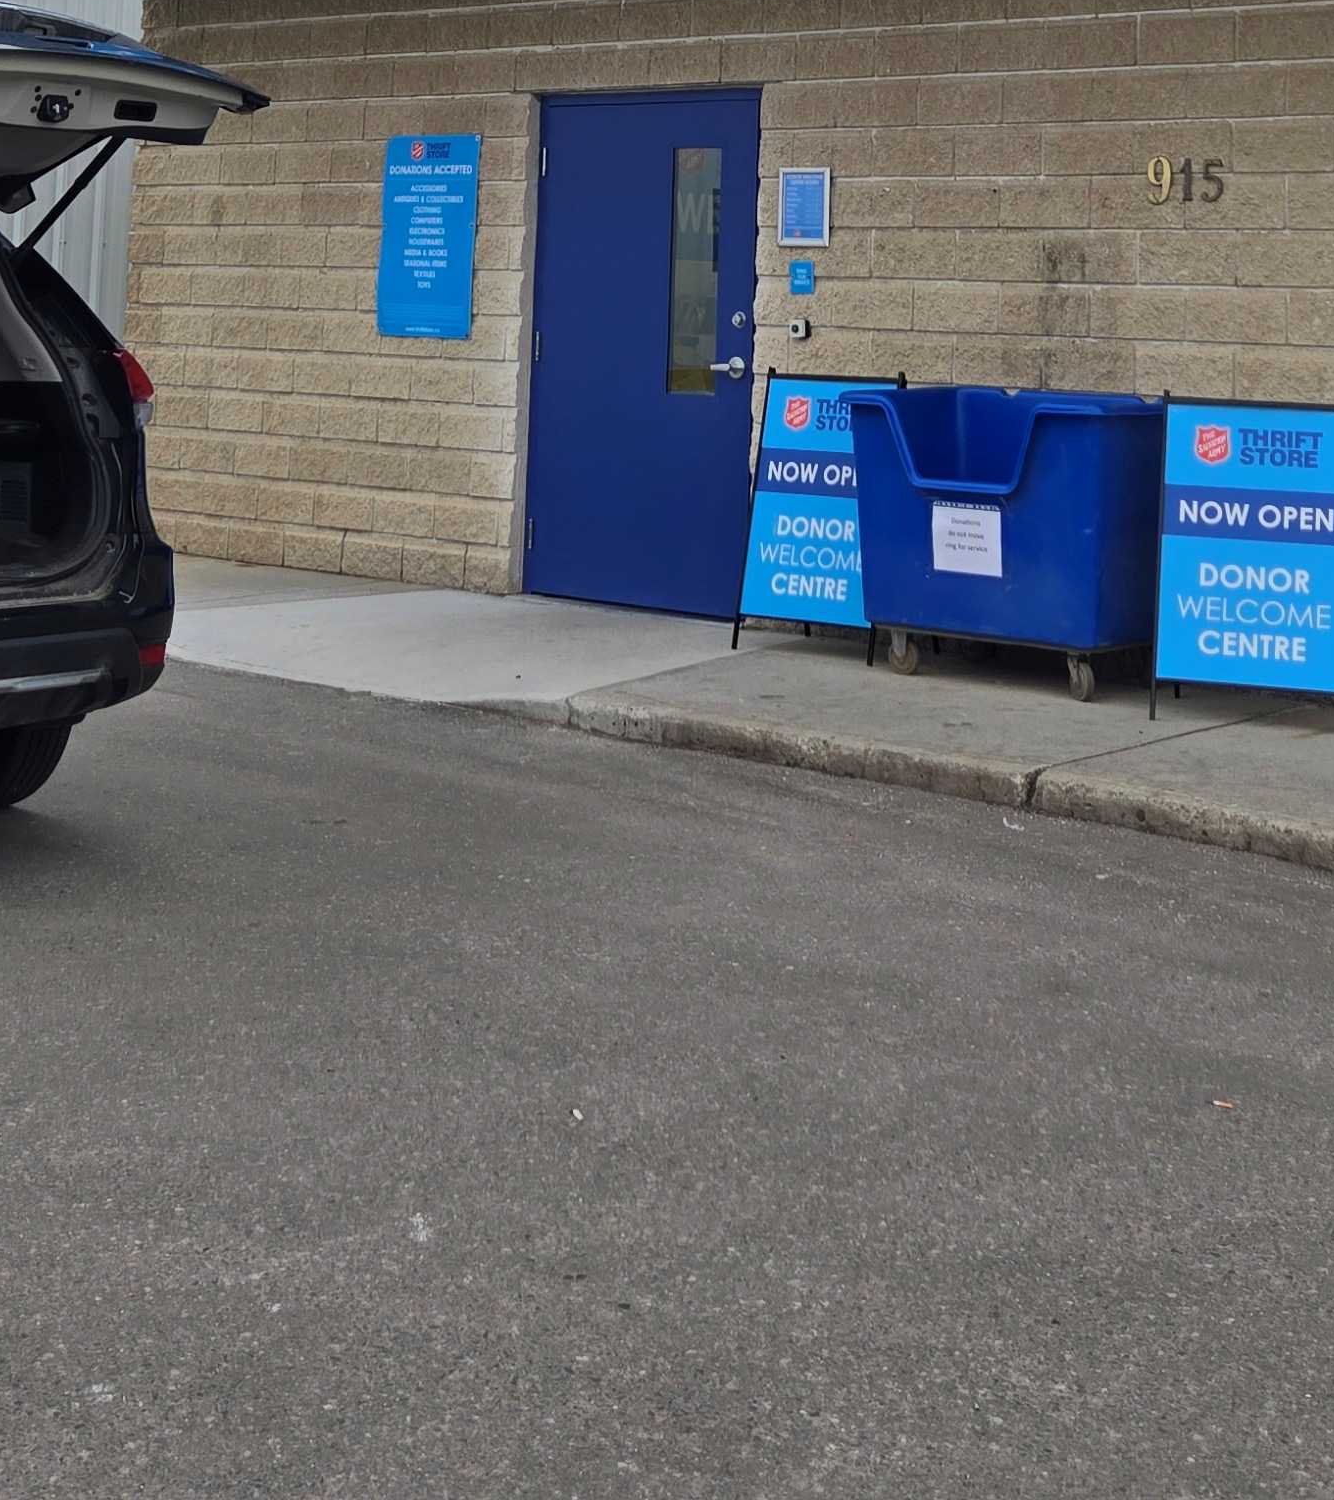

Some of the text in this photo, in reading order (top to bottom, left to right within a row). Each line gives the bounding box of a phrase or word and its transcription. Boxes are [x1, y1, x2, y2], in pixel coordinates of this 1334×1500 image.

[389, 164, 473, 175] DONATIONS ACCEPTED
[1147, 155, 1225, 205] 915
[1238, 427, 1324, 450] THRIFT
[767, 460, 818, 484] NOW
[1239, 448, 1320, 469] STORE
[777, 514, 856, 543] DONOR
[1178, 499, 1334, 533] NOW OPEN
[771, 572, 848, 602] CENTRE
[1199, 562, 1311, 595] DONOR
[1177, 593, 1332, 630] WELCOME
[1198, 629, 1307, 663] CENTRE
